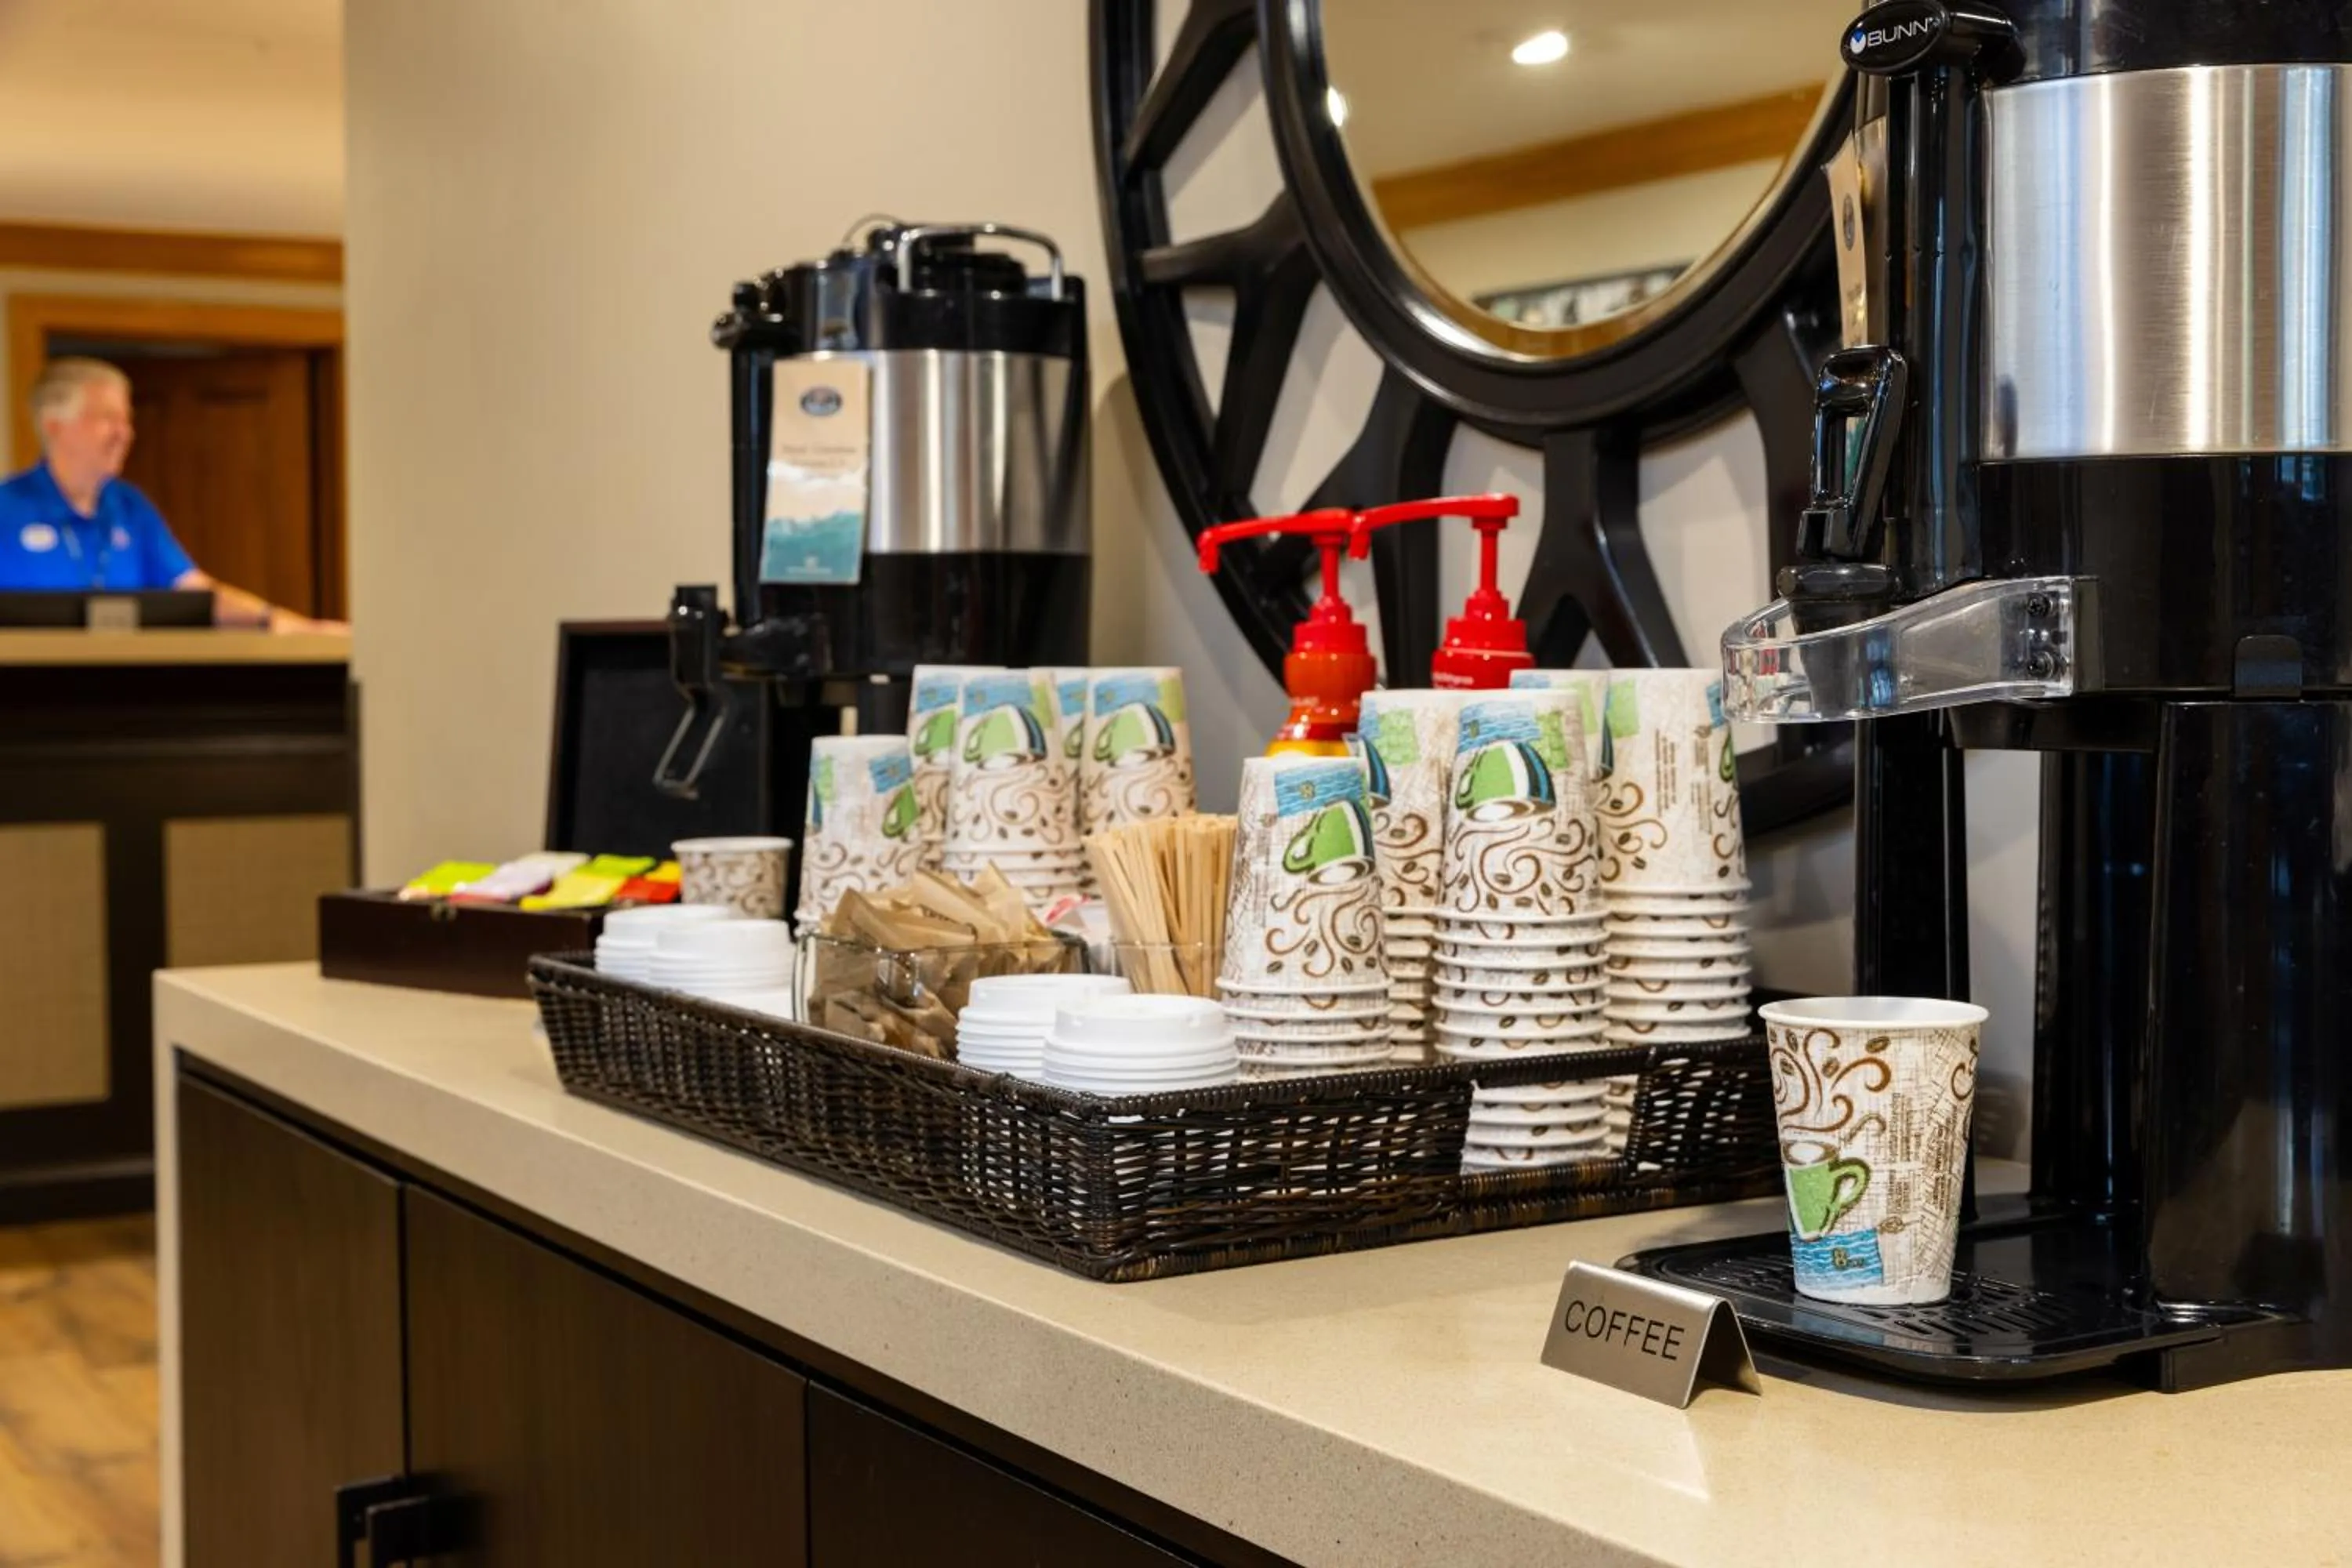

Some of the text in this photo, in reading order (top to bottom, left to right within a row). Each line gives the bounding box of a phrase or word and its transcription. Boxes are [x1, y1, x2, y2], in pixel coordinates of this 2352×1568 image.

[1867, 18, 1929, 47] BUNN
[1833, 1248, 1847, 1269] 8
[1565, 1300, 1685, 1360] COFFEE
